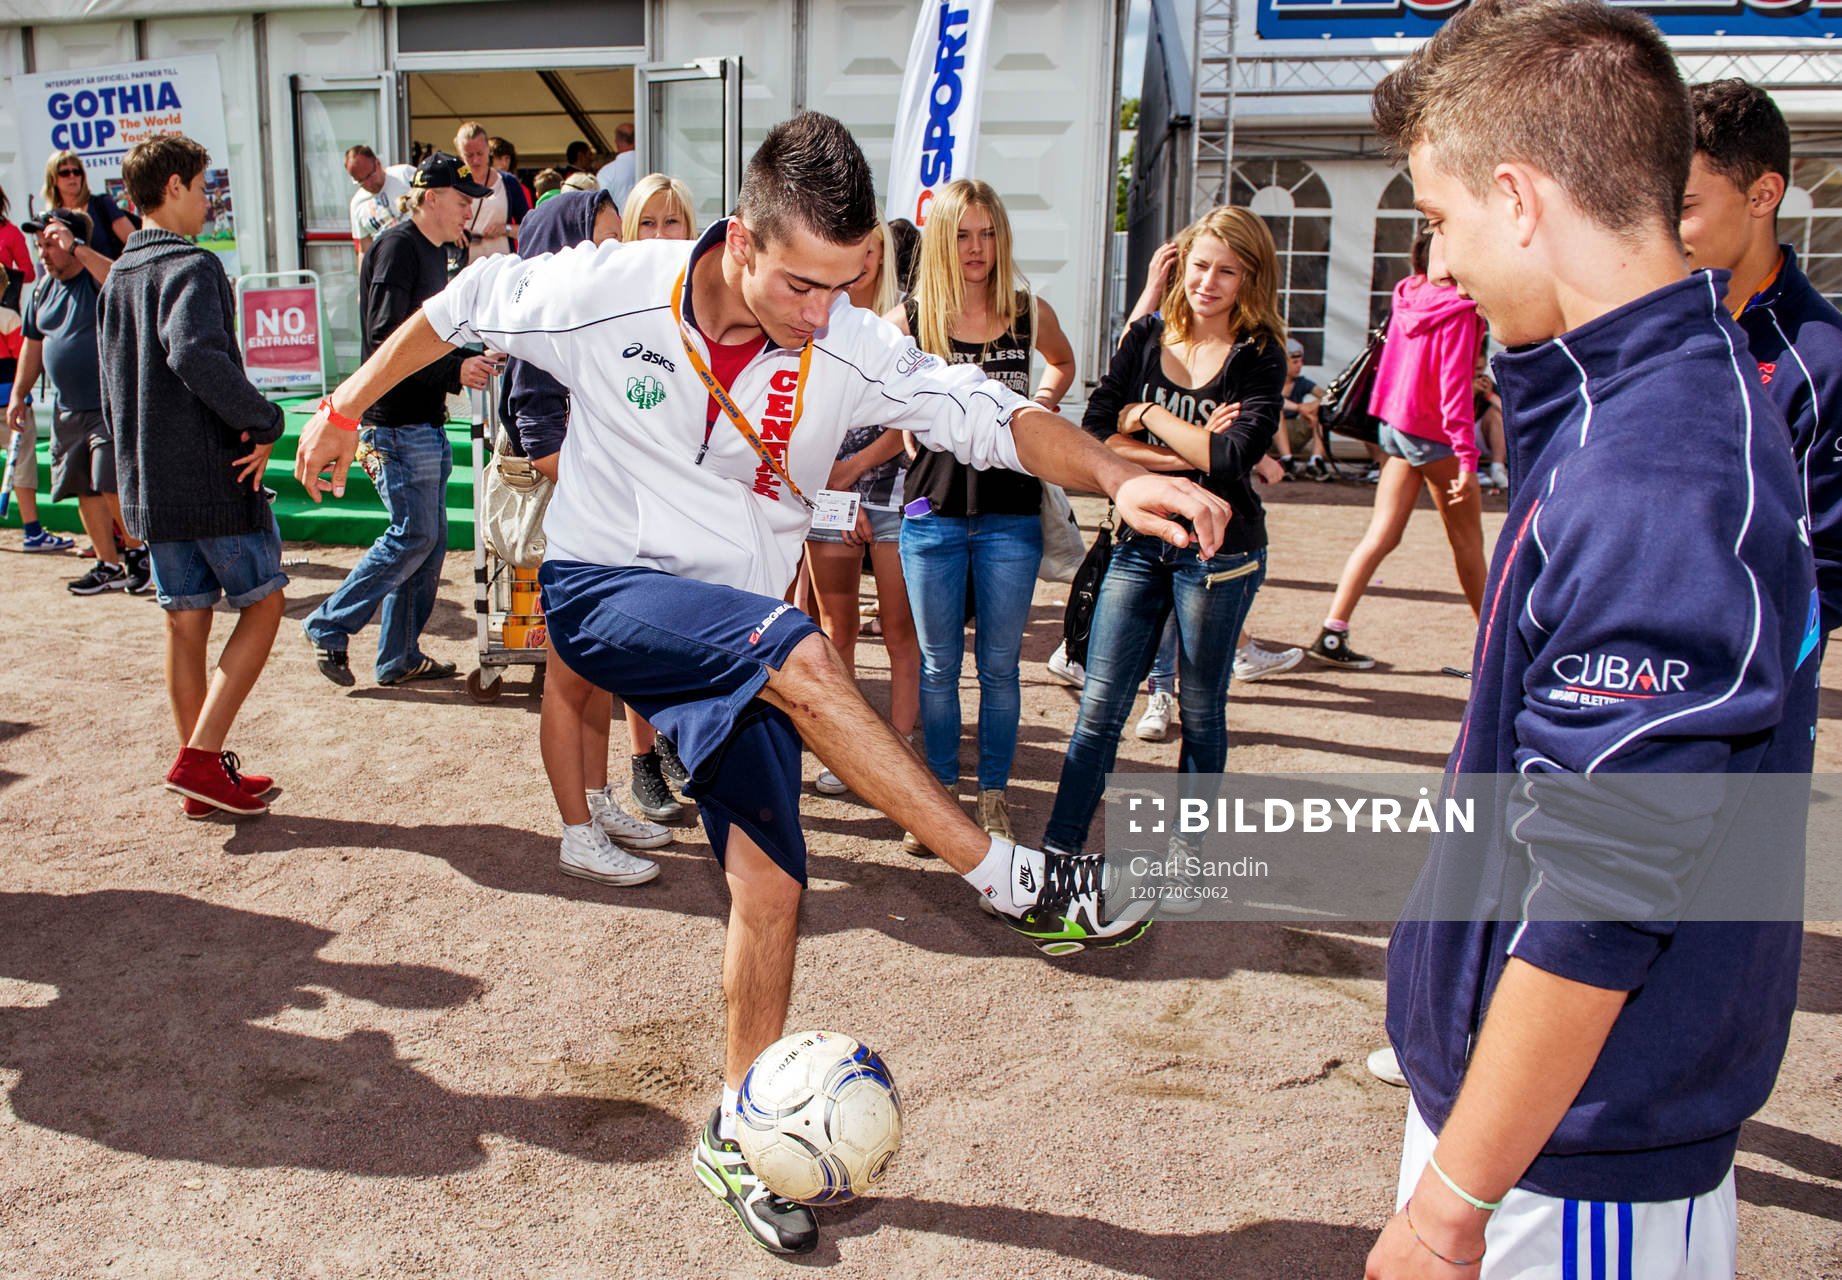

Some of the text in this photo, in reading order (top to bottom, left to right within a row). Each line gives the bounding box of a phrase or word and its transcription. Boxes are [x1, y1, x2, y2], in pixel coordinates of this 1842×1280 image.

[96, 73, 129, 84] OFFICIELL
[130, 70, 161, 80] PARTNER
[163, 67, 178, 76] TILL
[48, 81, 182, 121] GOTHIA
[119, 111, 182, 129] The World
[51, 119, 115, 151] CUP
[255, 306, 306, 337] NO
[248, 333, 316, 348] ENTRANCE
[641, 350, 676, 373] asics
[896, 346, 924, 374] CUB
[985, 349, 1026, 362] LESS
[700, 370, 740, 419] GOTHIA CUP
[1552, 653, 1690, 692] CUBAR
[1019, 864, 1031, 888] NIKE
